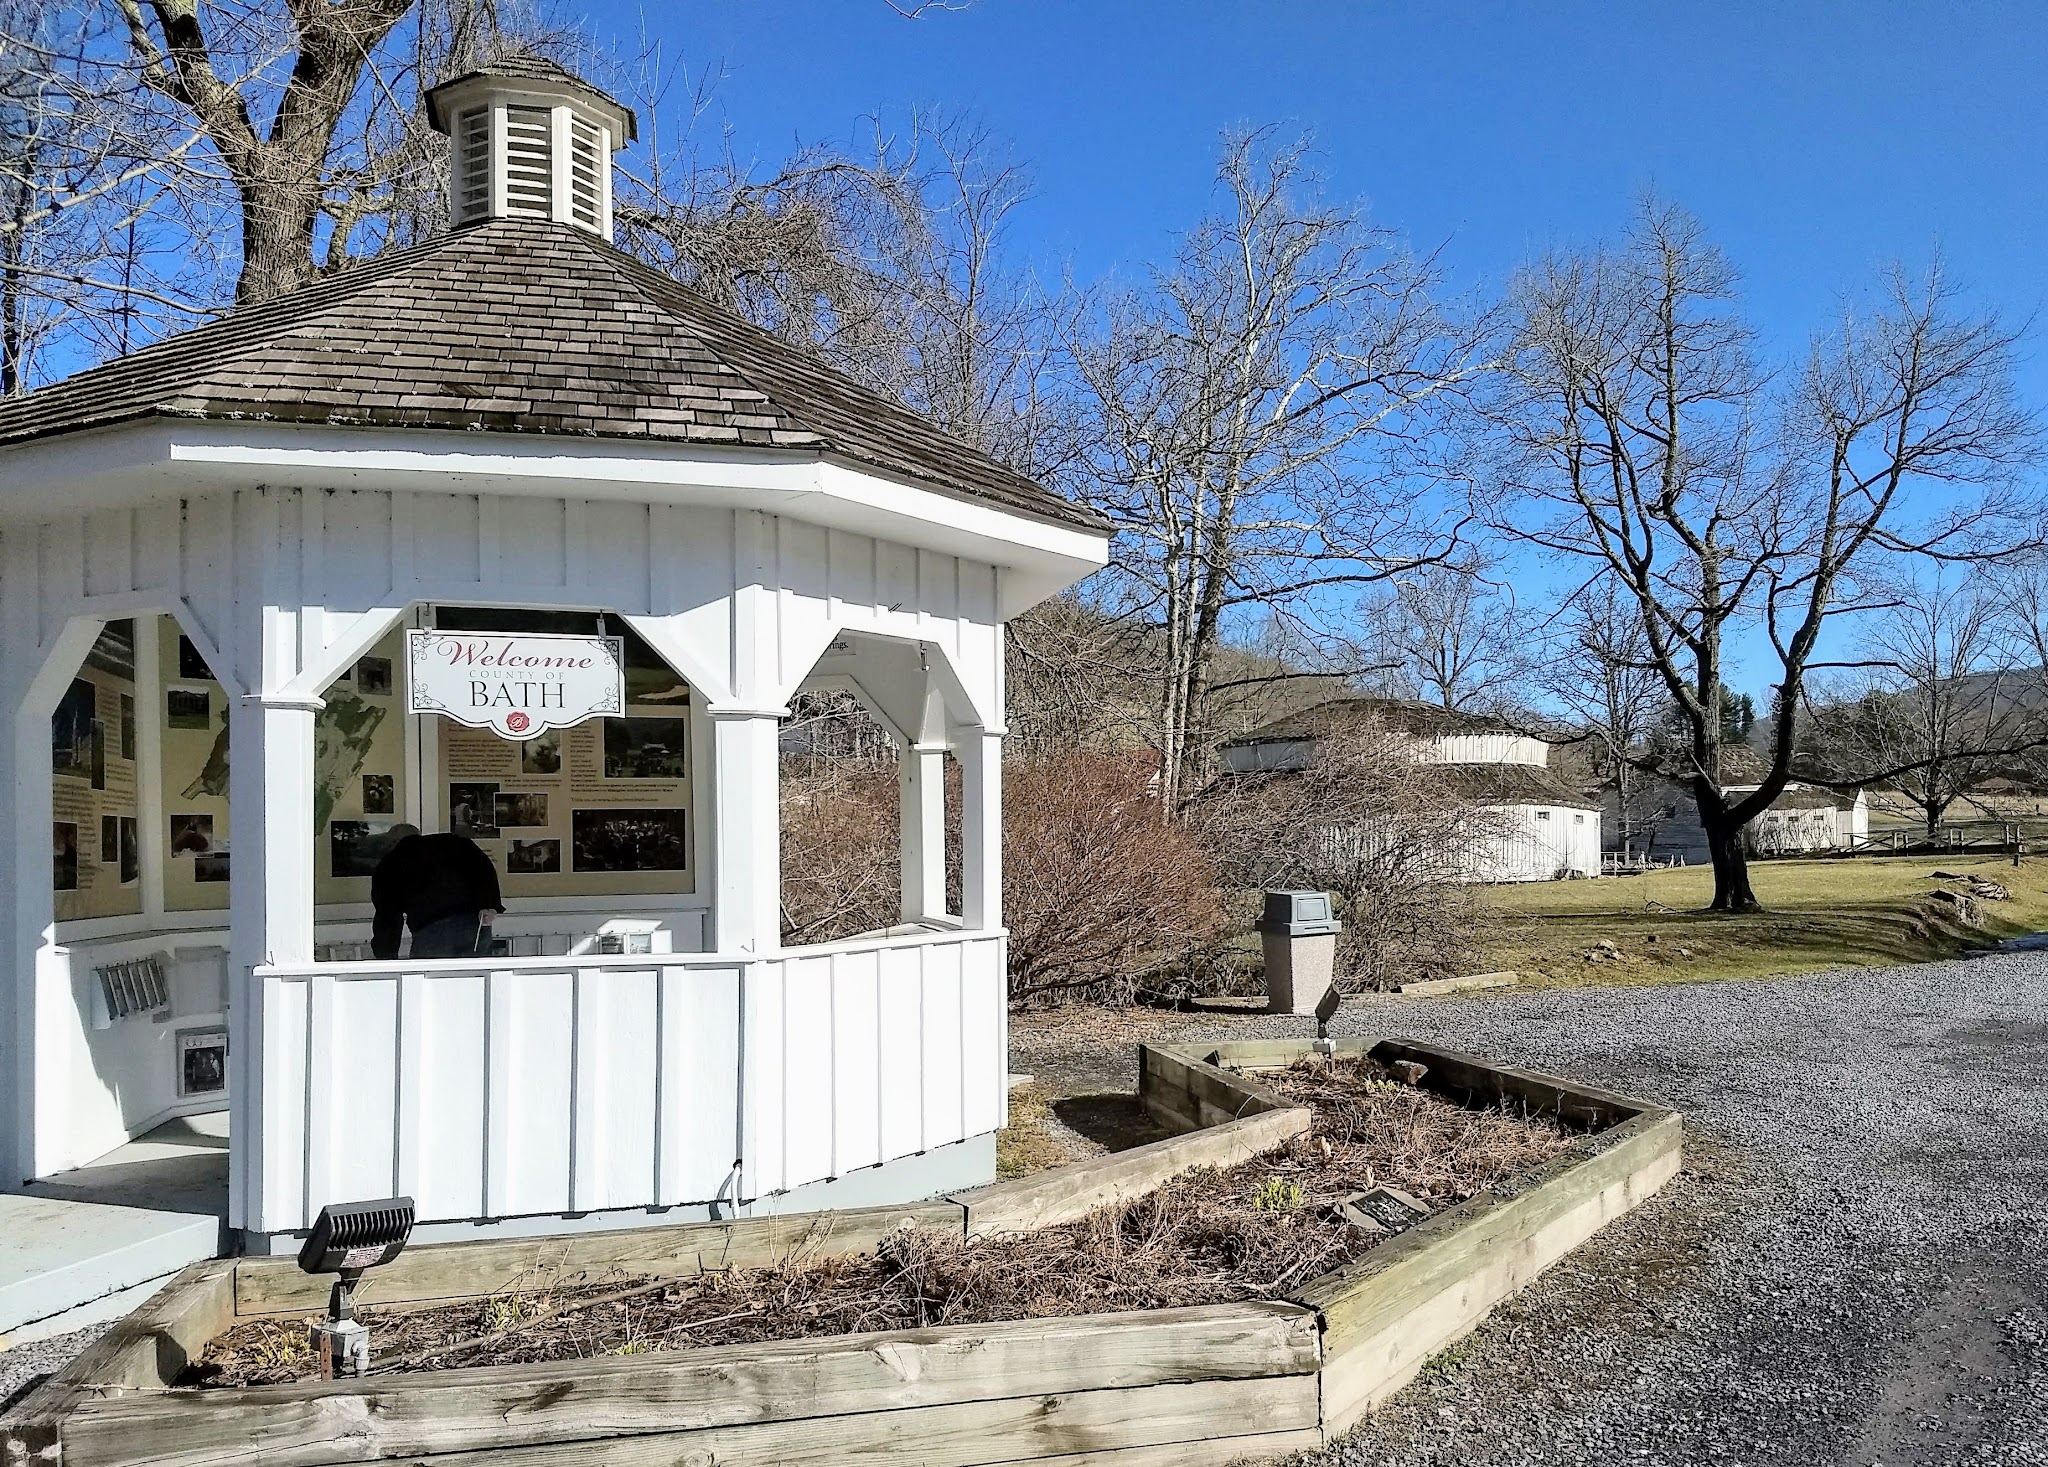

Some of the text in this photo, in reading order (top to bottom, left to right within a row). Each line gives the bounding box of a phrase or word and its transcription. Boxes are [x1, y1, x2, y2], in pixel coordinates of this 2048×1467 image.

[437, 640, 595, 669] Welcome
[469, 669, 565, 680] COUNTY OF
[468, 680, 566, 708] BATH
